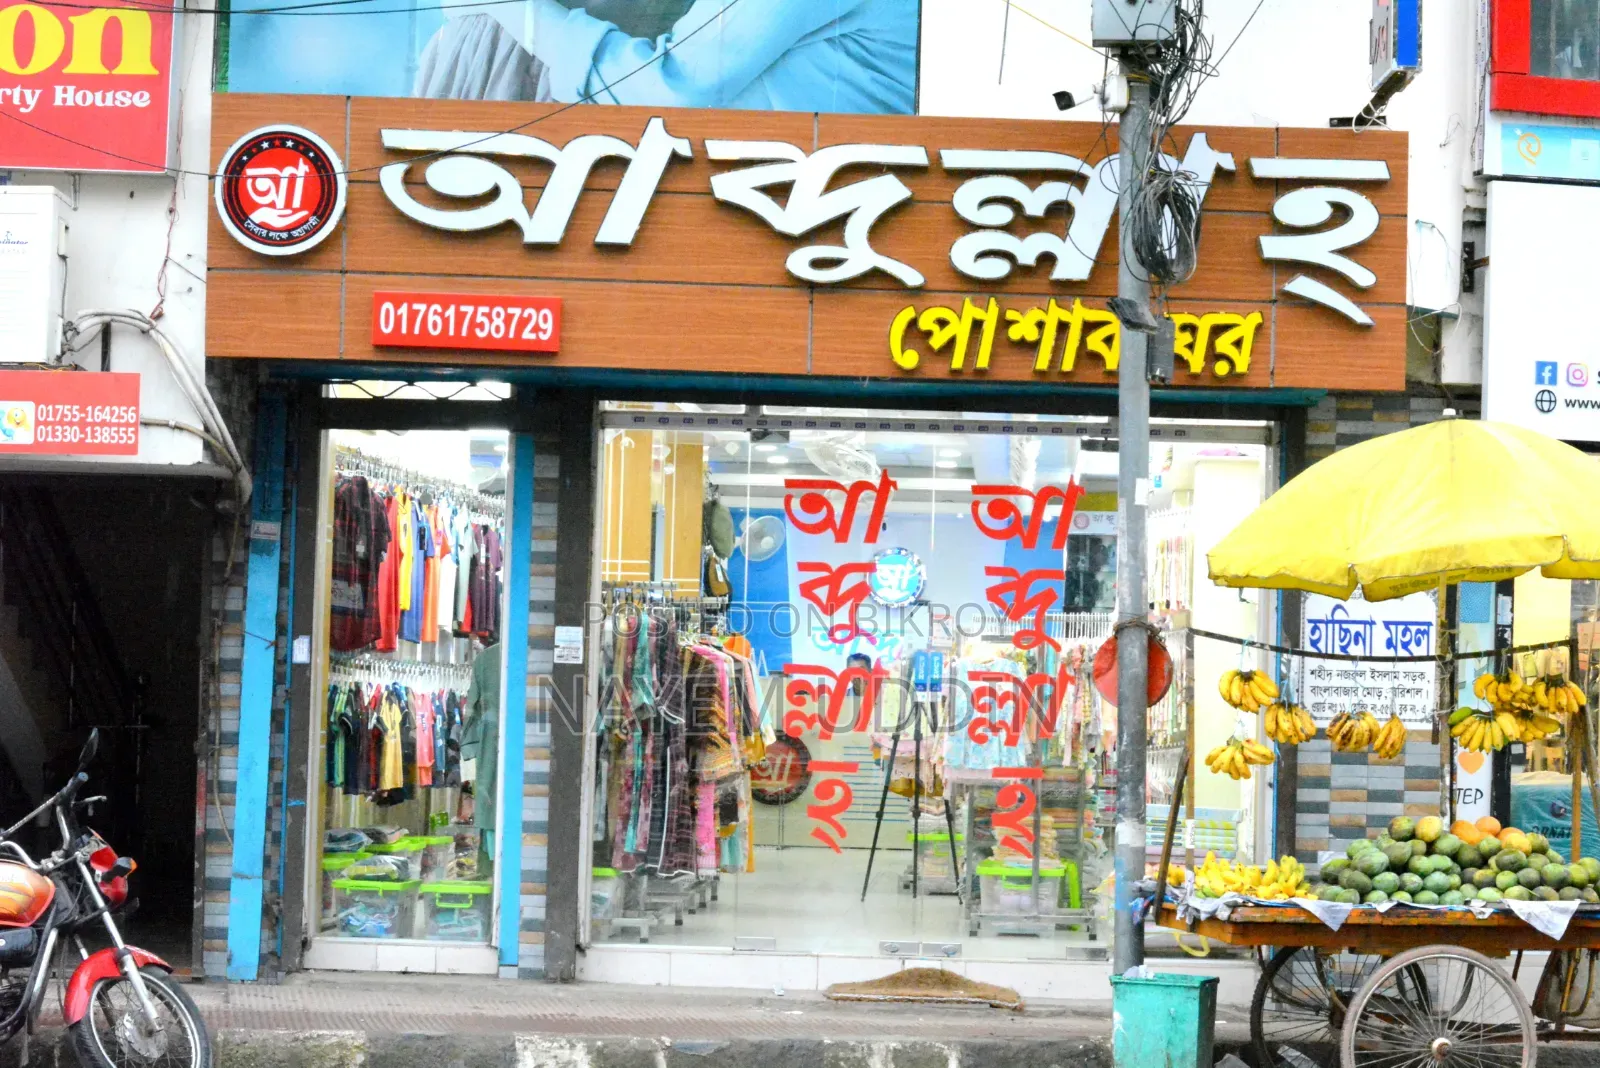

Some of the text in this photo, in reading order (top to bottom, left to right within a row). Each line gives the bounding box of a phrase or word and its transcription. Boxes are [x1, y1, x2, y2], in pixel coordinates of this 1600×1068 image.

[53, 85, 151, 108] House
[246, 157, 310, 210] আ
[379, 301, 553, 341] 01761758729
[37, 404, 137, 424] 01755-164256
[36, 425, 136, 444] 01330-138555
[1307, 603, 1434, 657] হাছিনা মহল
[1309, 665, 1333, 683] শহীদ
[1369, 667, 1400, 682] ইসলাম
